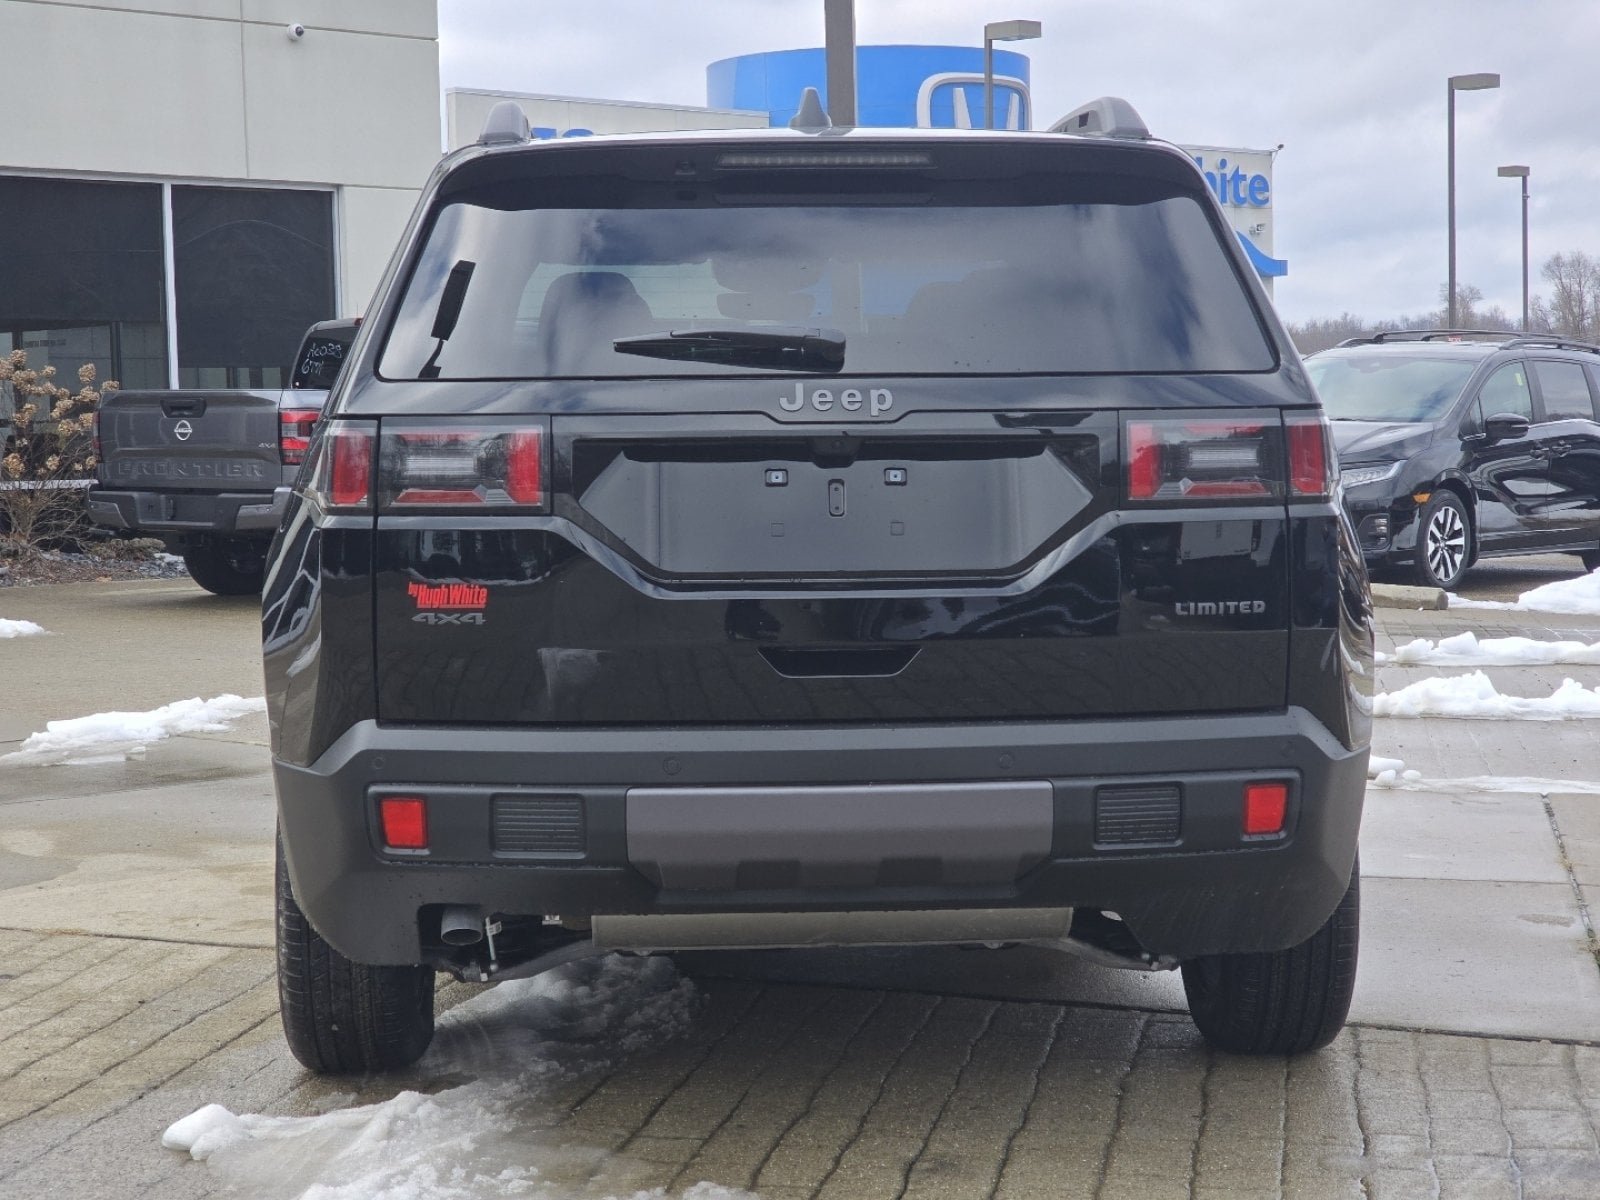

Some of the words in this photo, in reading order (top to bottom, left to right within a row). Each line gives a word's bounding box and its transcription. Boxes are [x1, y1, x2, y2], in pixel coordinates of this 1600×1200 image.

[779, 383, 893, 417] Jeep
[117, 462, 264, 477] FRONTIER
[417, 584, 449, 608] Hugh
[449, 584, 487, 606] White
[1175, 600, 1266, 616] LIMITED
